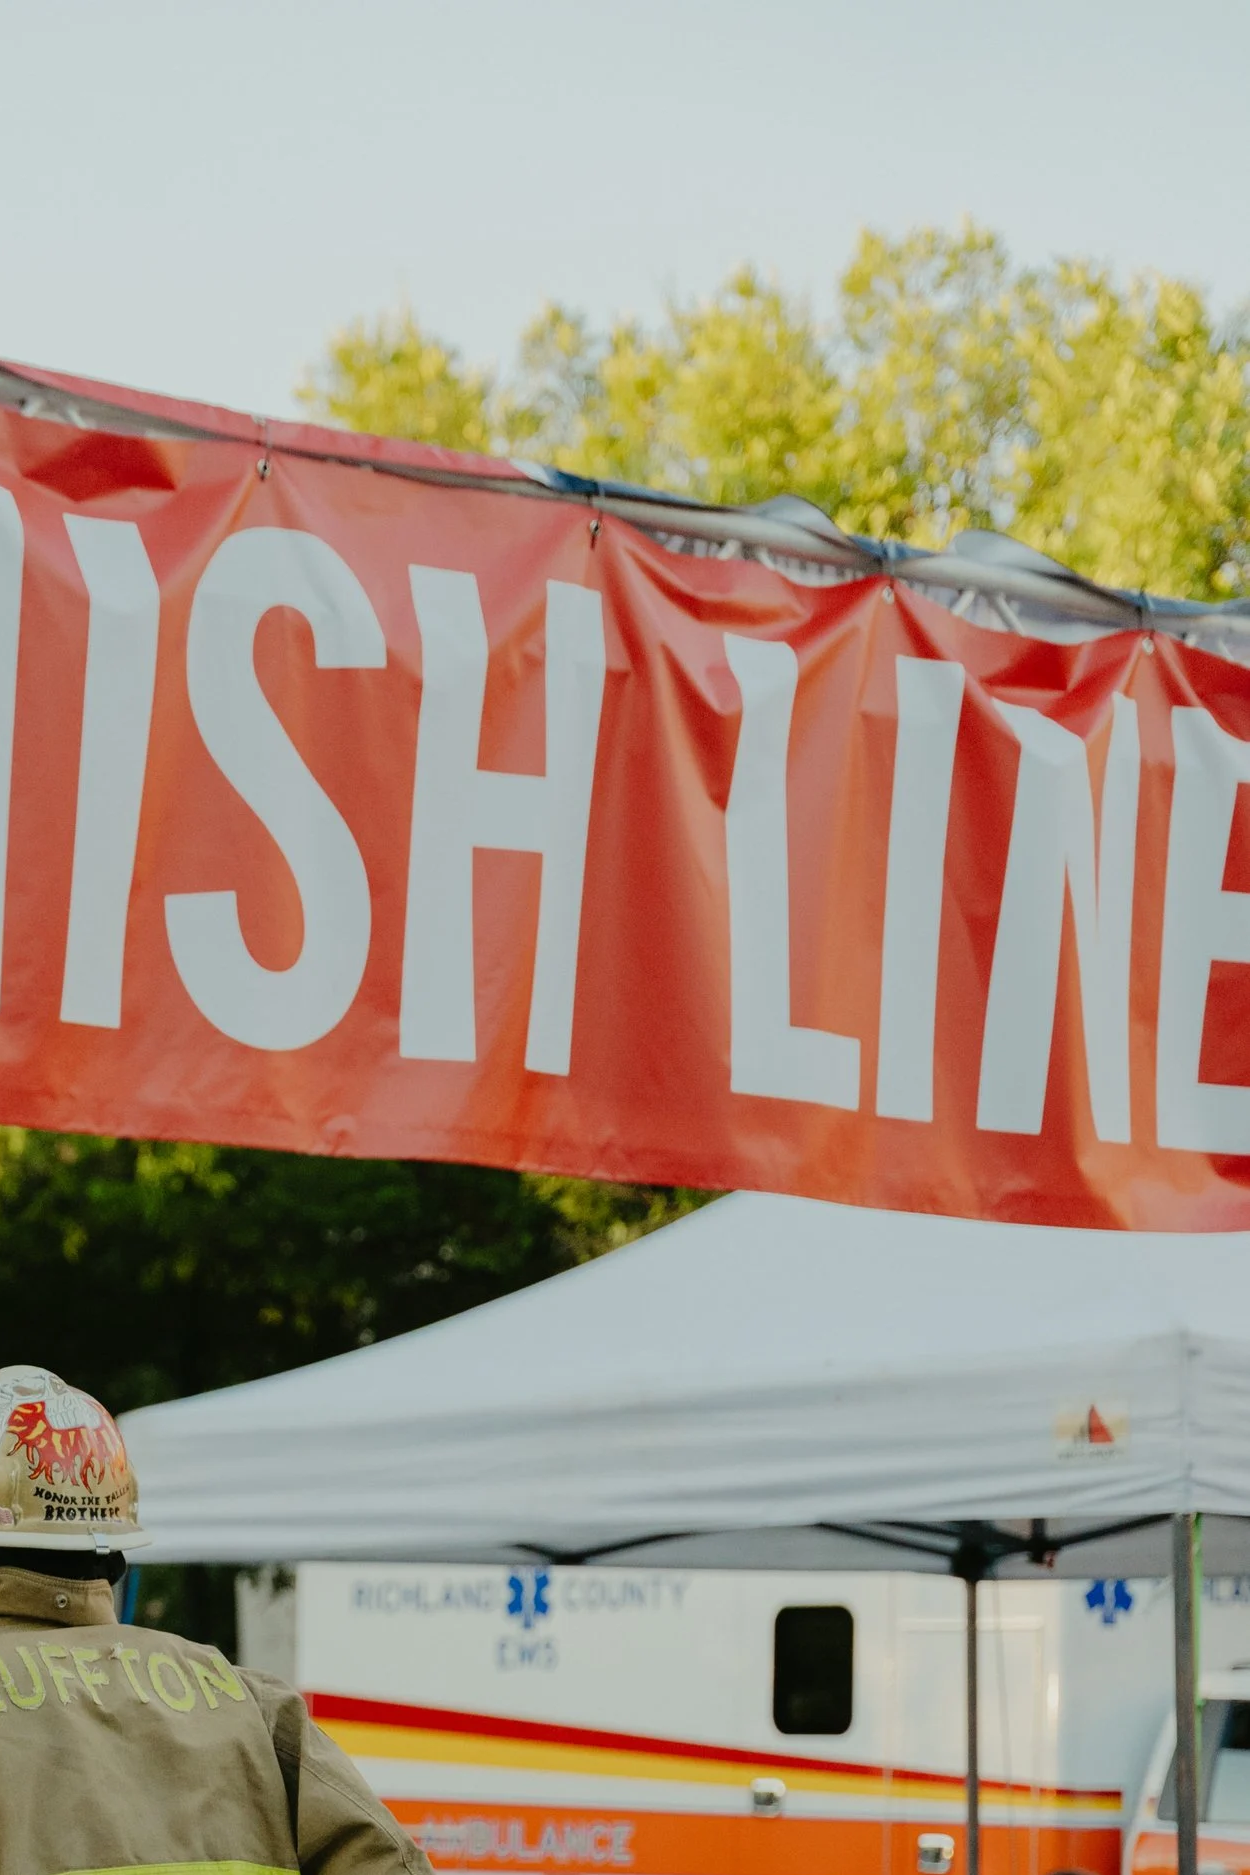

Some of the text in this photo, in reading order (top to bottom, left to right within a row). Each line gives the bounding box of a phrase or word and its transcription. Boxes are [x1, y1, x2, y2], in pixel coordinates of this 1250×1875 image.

[723, 632, 1250, 1156] LINE
[33, 1486, 77, 1505] HONOR
[81, 1495, 100, 1506] THE
[562, 1576, 692, 1611] COUNTY
[422, 1814, 636, 1867] AMBULANCE
